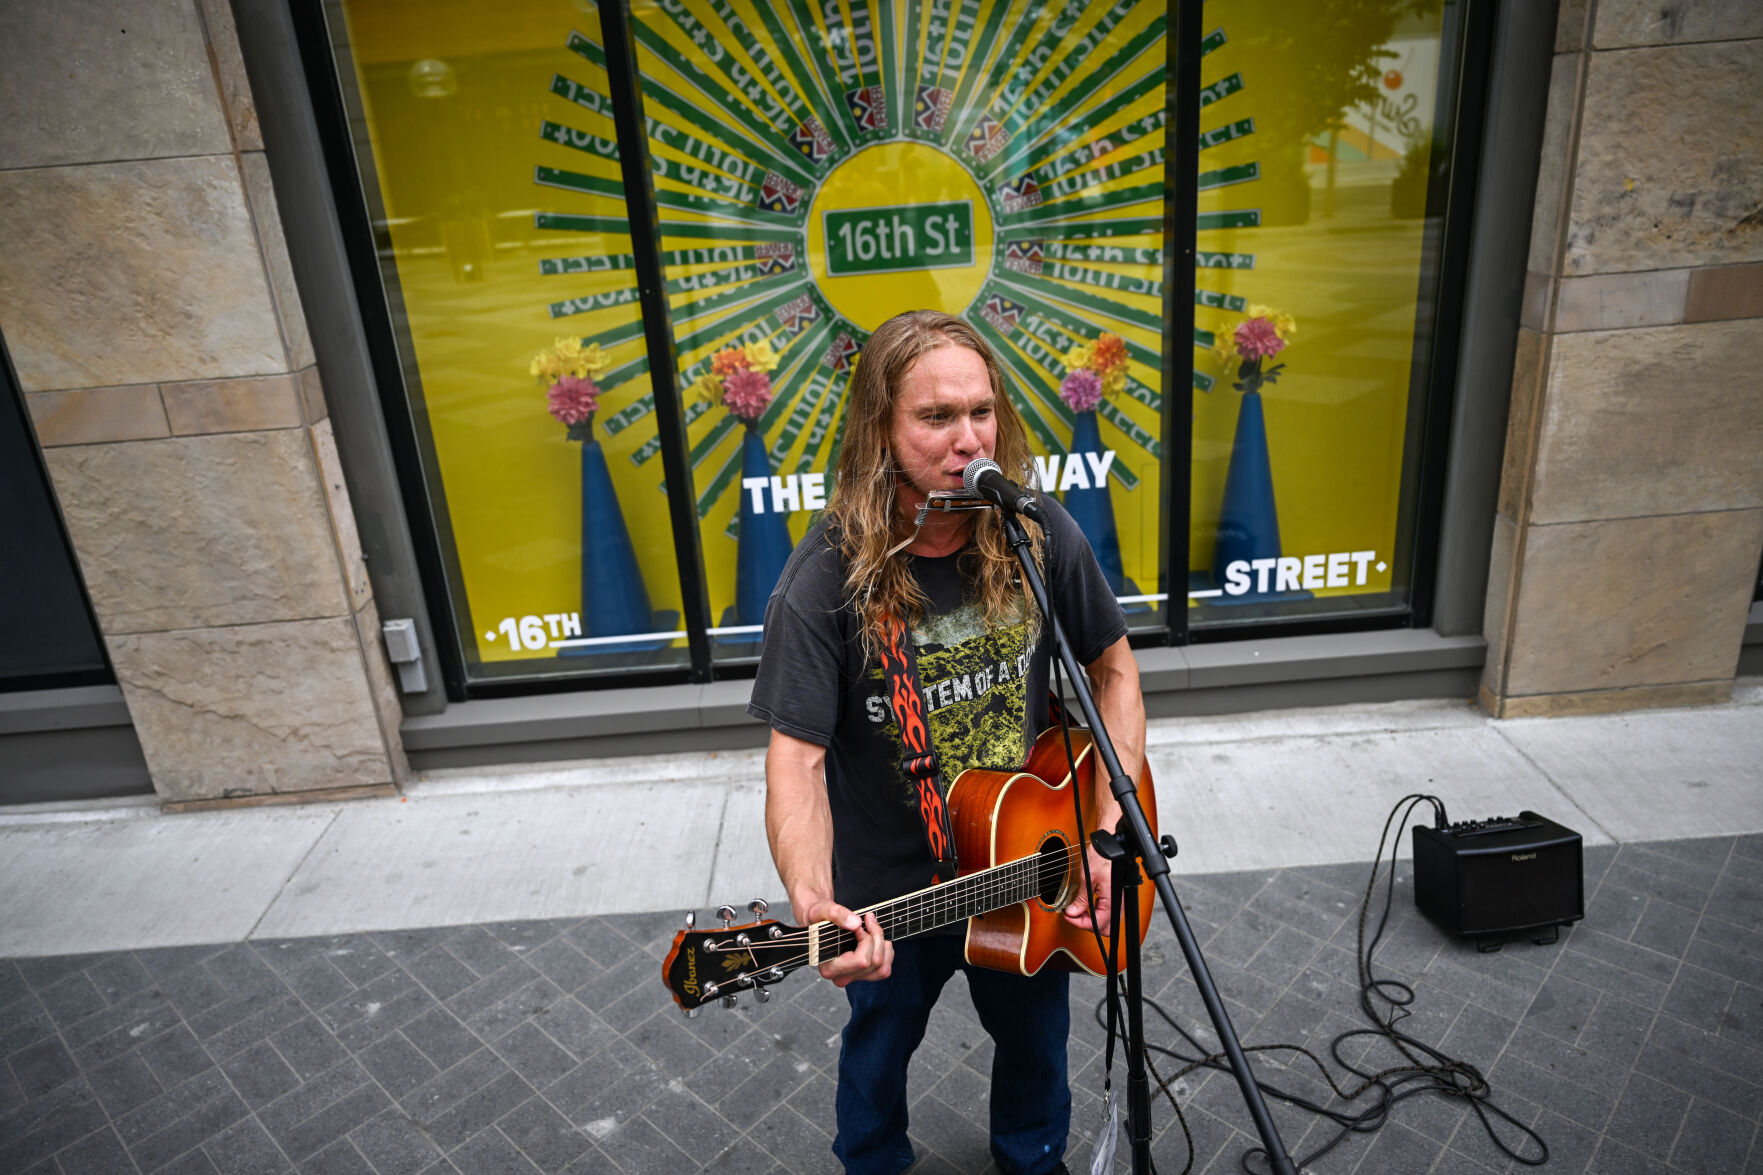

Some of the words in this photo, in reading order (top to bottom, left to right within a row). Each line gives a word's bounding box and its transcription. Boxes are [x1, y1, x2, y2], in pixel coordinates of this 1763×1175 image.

[839, 215, 915, 261] 16th
[925, 213, 961, 256] St
[743, 472, 826, 515] THE
[499, 612, 582, 651] 16TH
[1225, 550, 1376, 596] STREET
[866, 674, 973, 723] STEM
[975, 665, 993, 696] OF
[998, 661, 1011, 683] A
[1017, 644, 1036, 678] DO
[1511, 853, 1537, 862] Roland
[684, 946, 701, 998] Ibanez
